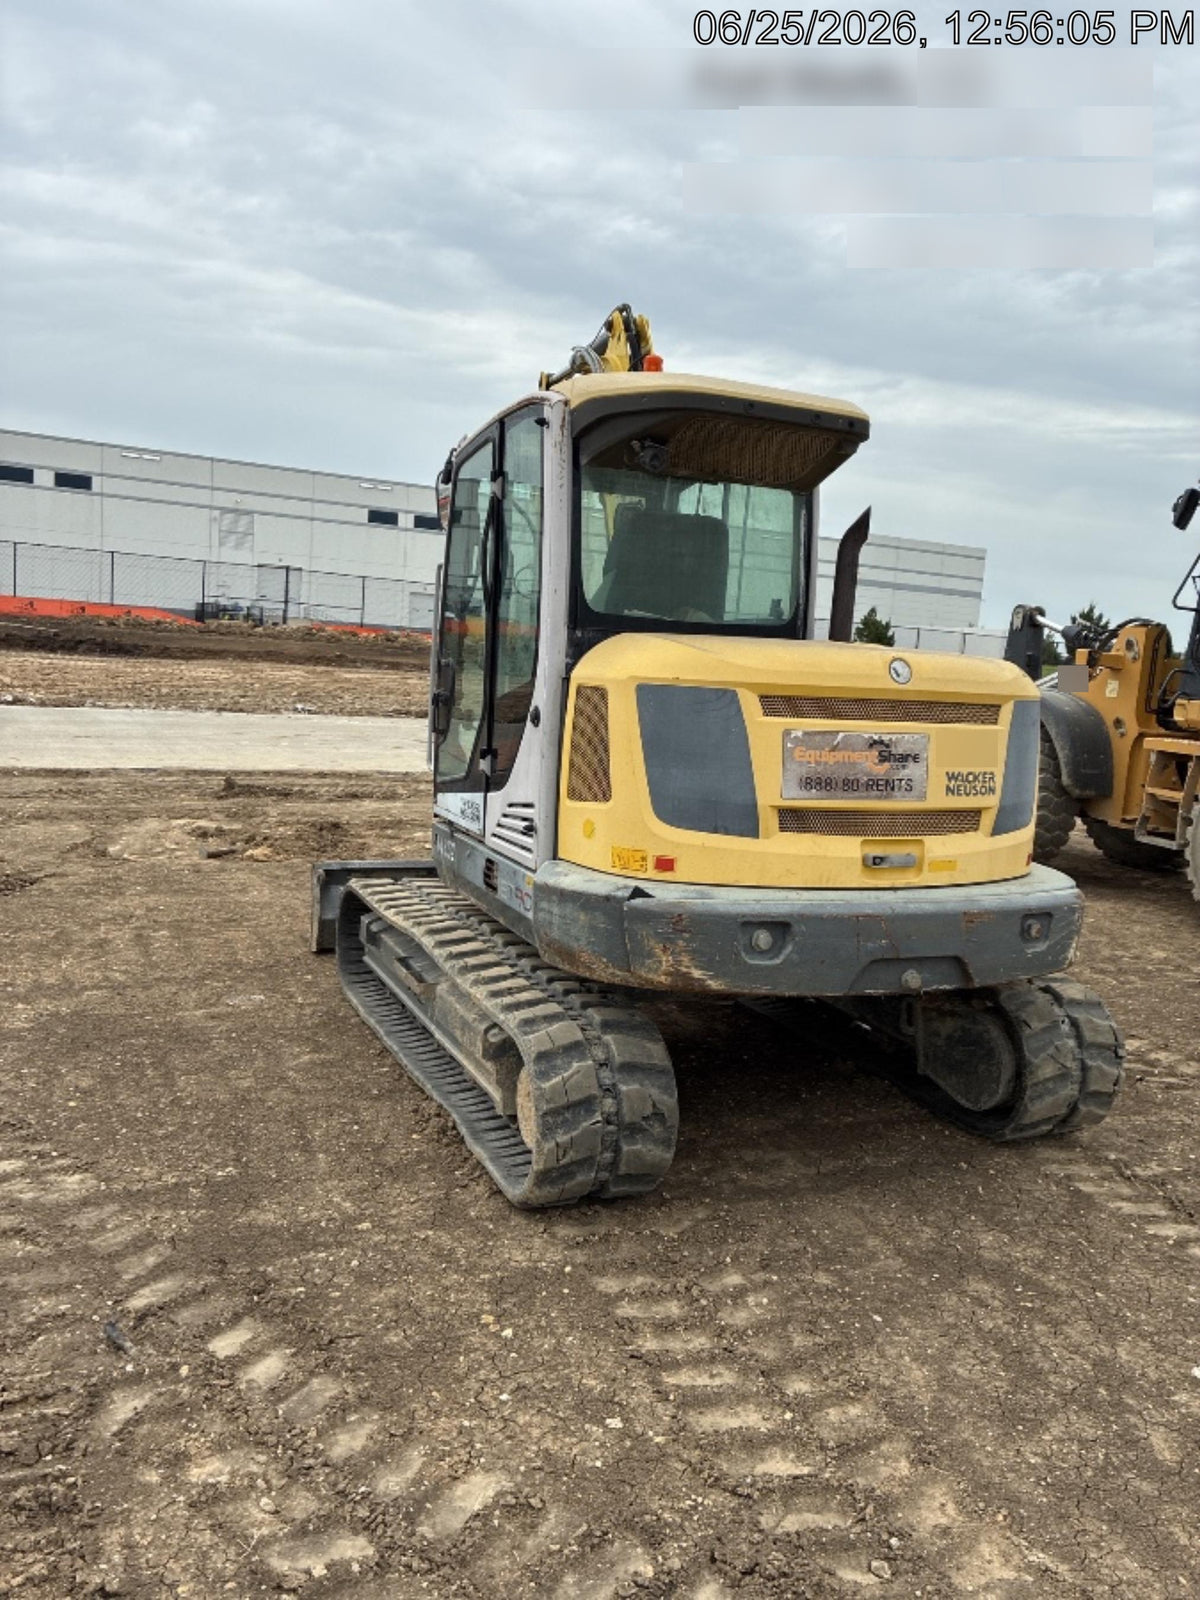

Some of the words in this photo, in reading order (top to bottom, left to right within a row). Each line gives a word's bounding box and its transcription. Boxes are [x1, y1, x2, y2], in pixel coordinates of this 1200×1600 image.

[945, 771, 995, 784] WACKER
[866, 778, 913, 792] RENTS
[945, 784, 996, 797] NEUSON
